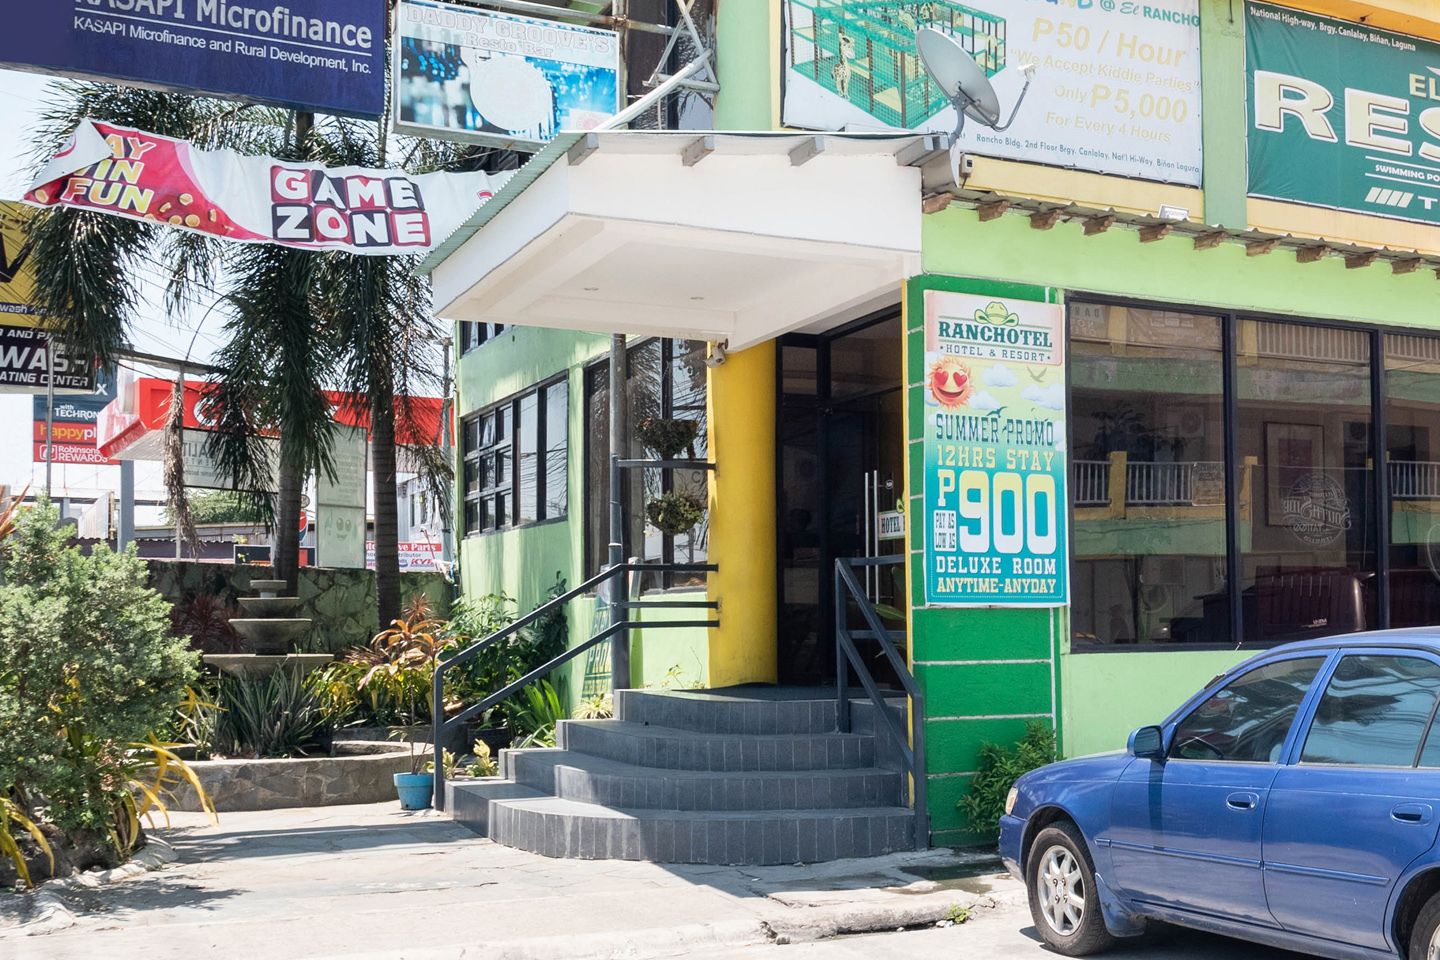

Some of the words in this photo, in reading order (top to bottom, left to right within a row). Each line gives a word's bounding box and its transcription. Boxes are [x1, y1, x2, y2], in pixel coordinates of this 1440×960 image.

[1120, 1, 1139, 16] El
[1144, 6, 1200, 28] RANCHO
[407, 6, 488, 33] DADDY
[495, 20, 610, 54] GROOVE'S
[1250, 6, 1281, 20] National
[1282, 13, 1317, 31] High-way,
[1319, 21, 1338, 35] Brgy.
[1391, 39, 1416, 52] Laguna
[73, 16, 126, 37] KASAPI
[130, 24, 206, 48] Microfinance
[209, 38, 232, 53] and
[235, 41, 267, 58] Rural
[270, 46, 349, 73] Development,
[352, 59, 372, 74] Inc.
[1116, 32, 1187, 68] Hour
[1044, 55, 1094, 76] Accept
[1099, 64, 1143, 82] Kiddie
[1055, 85, 1088, 104] Only
[1046, 111, 1070, 127] For
[1074, 115, 1115, 136] Every
[1118, 122, 1126, 134] 4
[1131, 125, 1172, 142] Hours
[976, 133, 1003, 145] Rancho
[1025, 140, 1038, 149] 2nd
[1040, 142, 1058, 152] Floor
[1375, 164, 1426, 181] SWIMMING
[61, 178, 154, 213] FUN
[273, 167, 421, 210] GAME
[275, 205, 428, 245] ZONE
[7, 330, 33, 340] AND
[938, 320, 1053, 348] RANCHOTEL
[946, 344, 983, 356] HOTEL
[989, 349, 996, 357] &
[1002, 349, 1045, 362] RESORT
[55, 408, 99, 420] TECHRON
[936, 413, 999, 443] SUMMER
[1006, 418, 1054, 446] PROMO
[58, 445, 100, 454] Robinsons
[58, 453, 108, 463] REWARDS
[937, 444, 996, 469] 12HRS
[1006, 448, 1055, 472] STAY
[881, 515, 900, 534] HOTEL
[935, 512, 946, 529] PAY
[948, 512, 955, 529] AS
[949, 532, 956, 549] AS
[936, 555, 1002, 574] DELUXE
[1012, 557, 1057, 575] ROOM
[936, 577, 1057, 594] ANYTIME-ANYDAY
